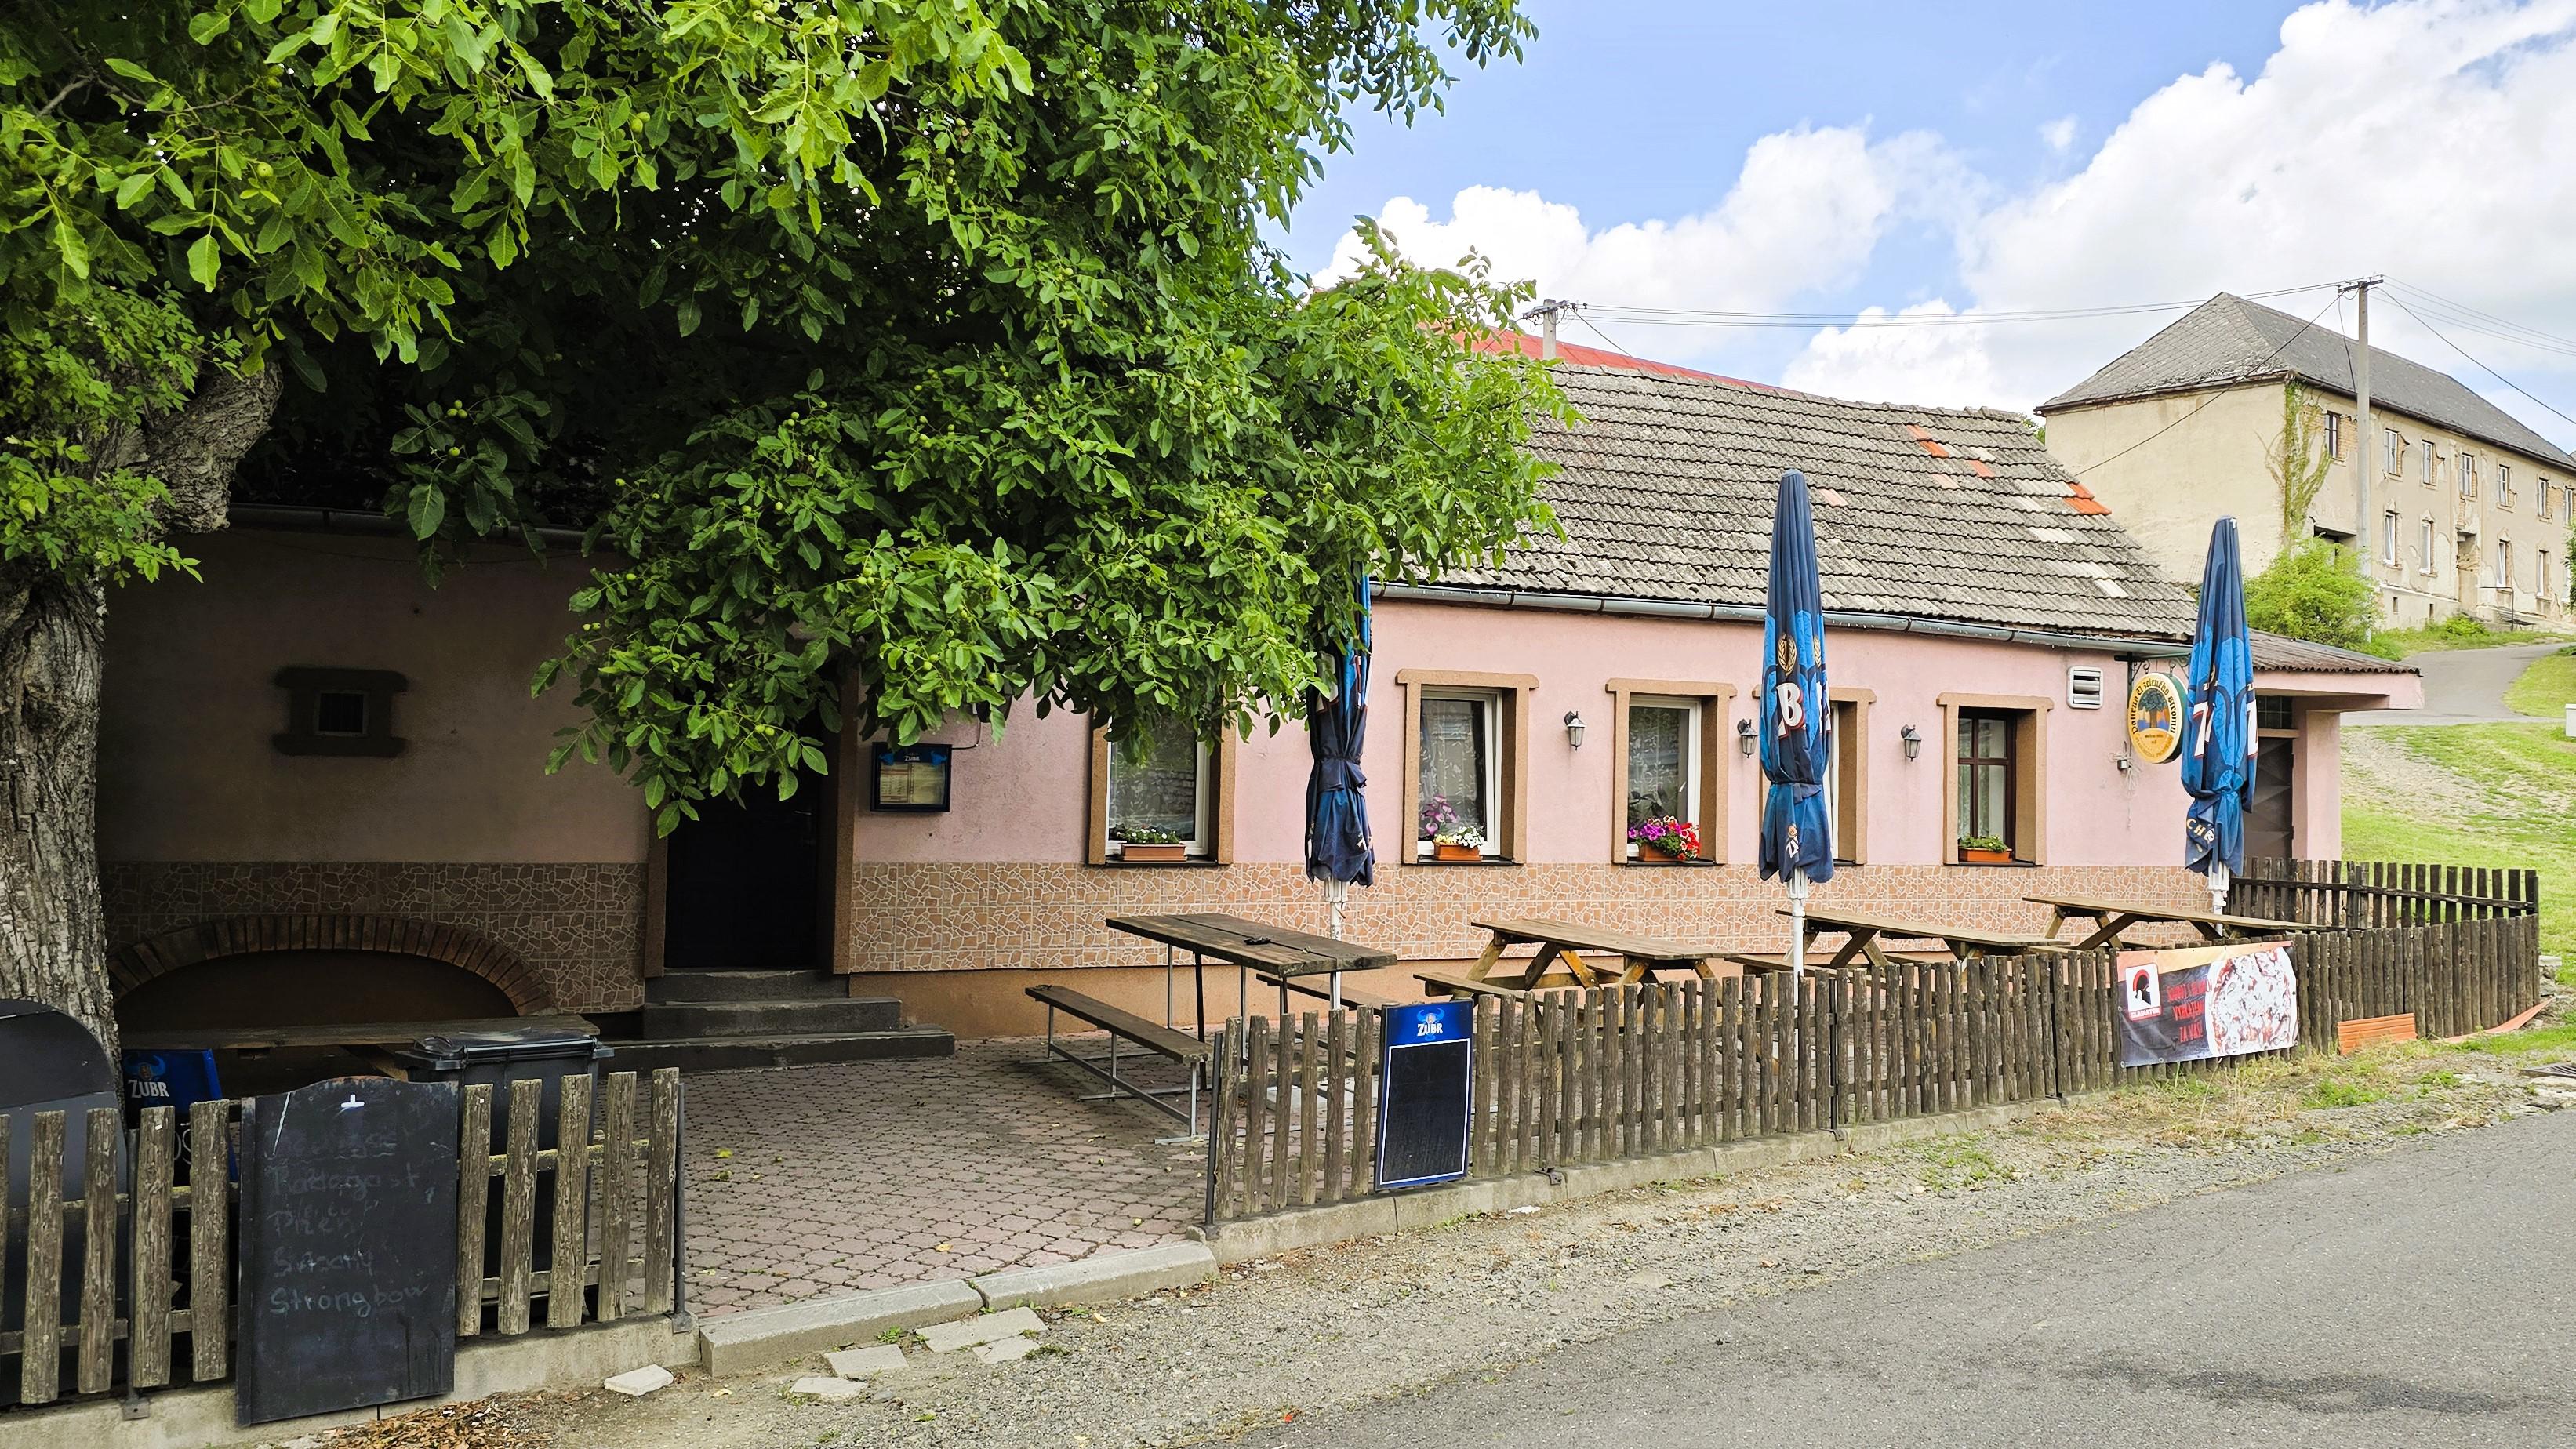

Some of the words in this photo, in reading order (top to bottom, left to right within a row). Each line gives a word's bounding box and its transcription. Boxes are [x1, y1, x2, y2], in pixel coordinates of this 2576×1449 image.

[1416, 1023, 1444, 1037] ZUBR
[128, 1079, 170, 1099] ZUBR
[271, 1284, 431, 1319] Strongbow
